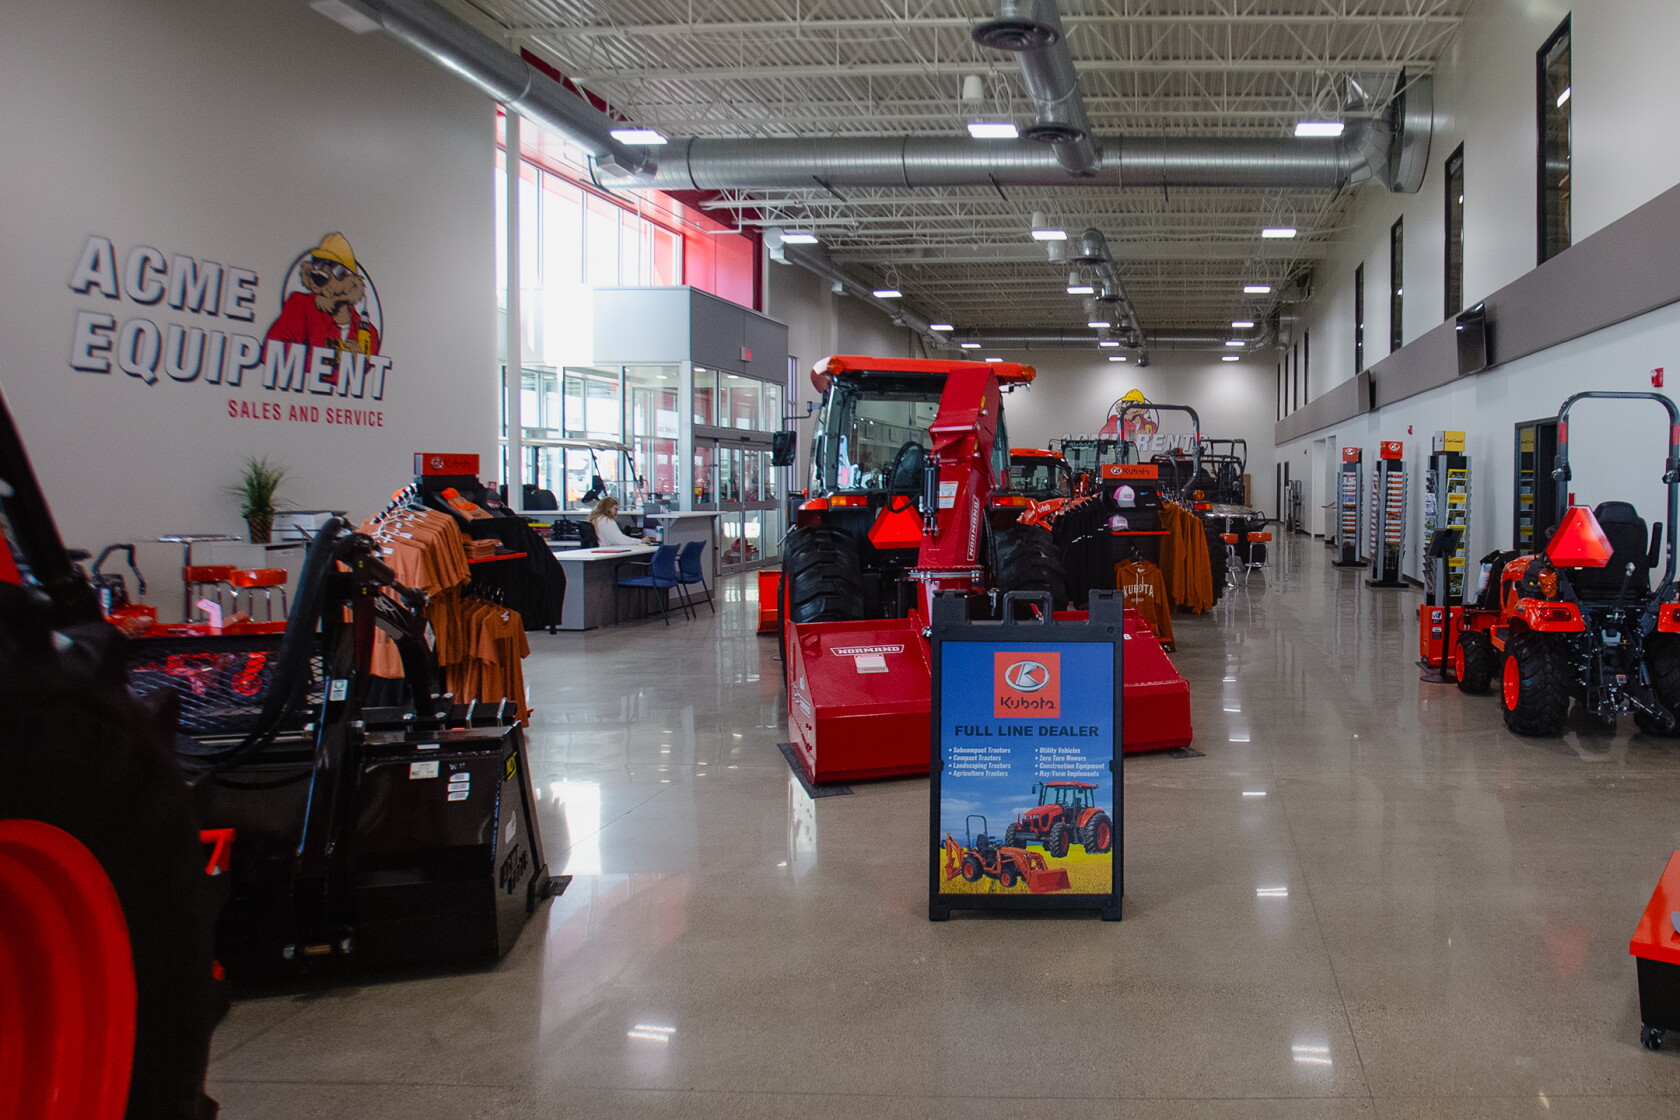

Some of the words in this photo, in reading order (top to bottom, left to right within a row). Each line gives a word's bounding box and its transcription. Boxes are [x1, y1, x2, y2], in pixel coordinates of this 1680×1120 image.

[69, 234, 258, 323] ACME
[70, 308, 392, 401] EQUIPMENT
[228, 399, 282, 420] SALES
[289, 405, 319, 424] AND
[326, 407, 384, 428] SERVICE
[1124, 467, 1150, 475] Kubota
[969, 501, 979, 556] NORMAND
[1123, 584, 1154, 599] KUBOTA
[837, 646, 900, 654] NORMAND
[1000, 696, 1055, 709] Kubota
[954, 725, 993, 737] FULL
[998, 725, 1033, 737] LINE
[1038, 725, 1099, 737] DEALER
